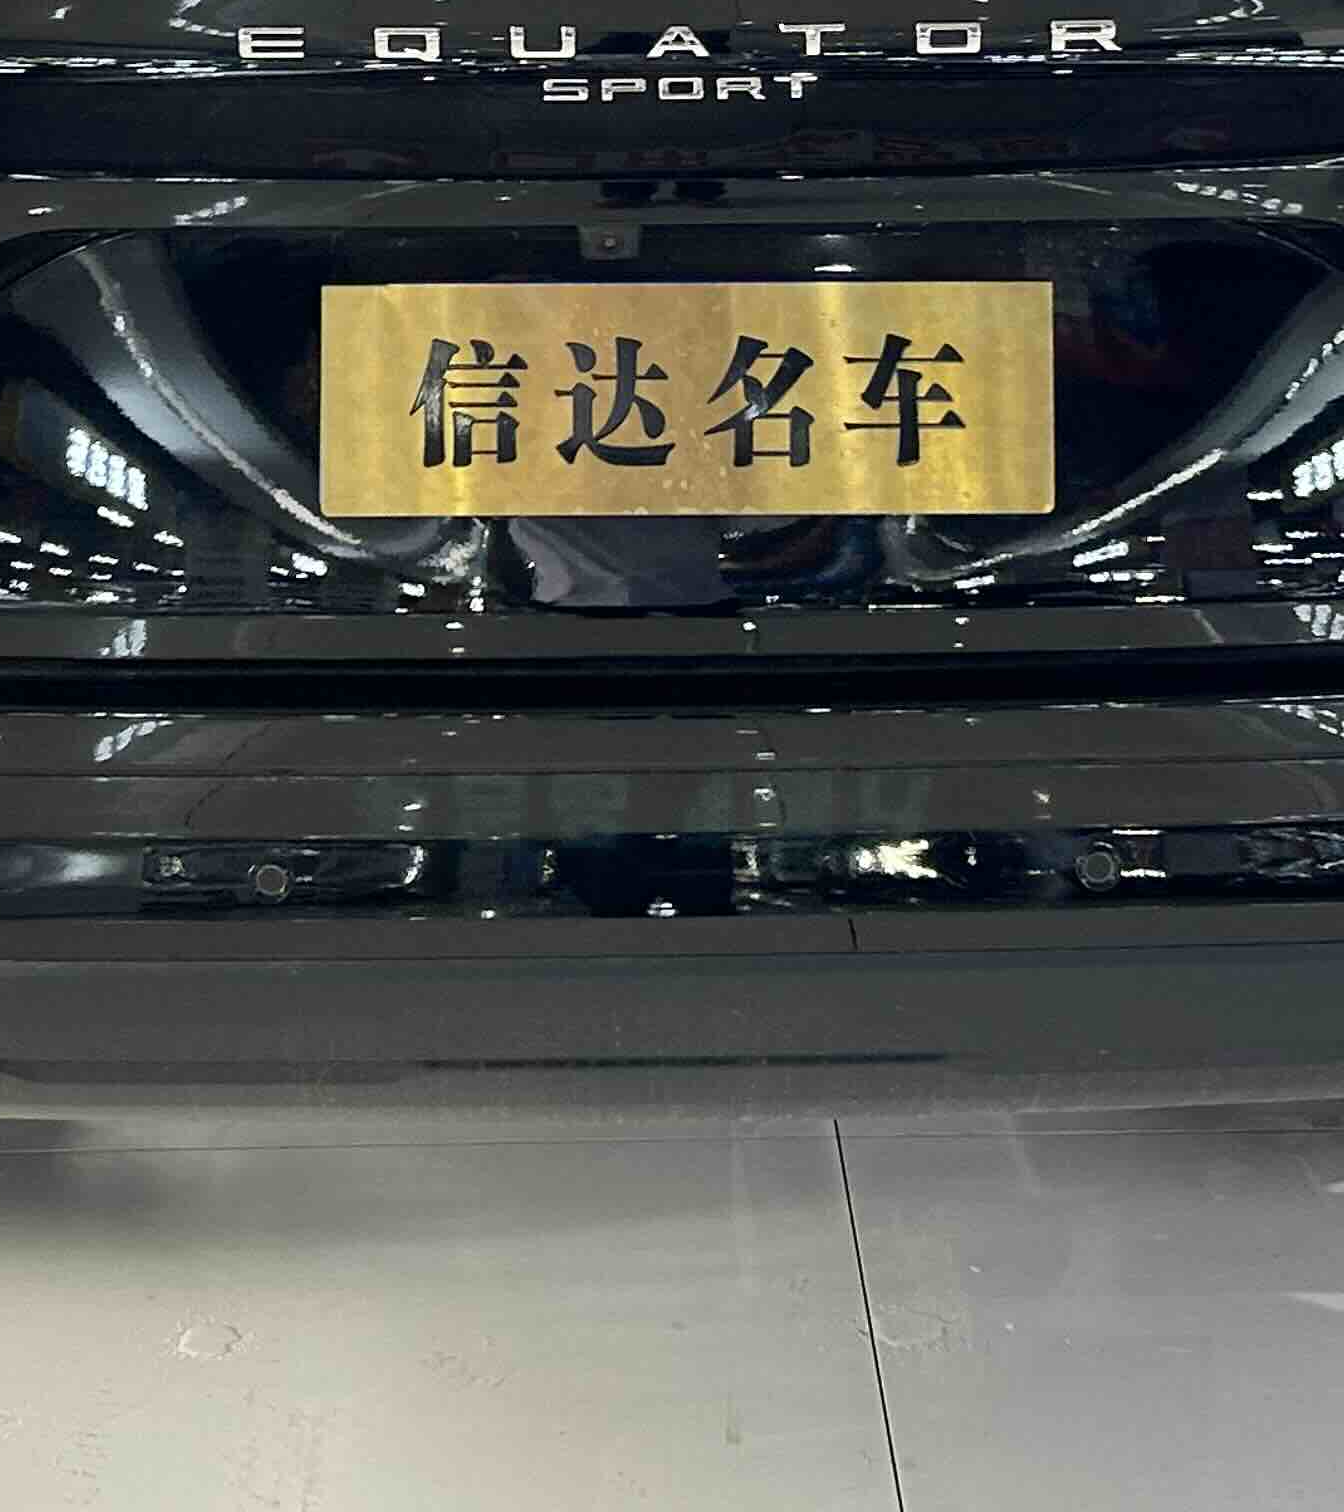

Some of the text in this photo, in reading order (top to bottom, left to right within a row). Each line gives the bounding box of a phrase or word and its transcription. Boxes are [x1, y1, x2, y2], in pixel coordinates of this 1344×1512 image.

[238, 18, 1122, 61] EQUATOR
[542, 72, 820, 103] SPORT
[409, 332, 967, 468] 信达名车
